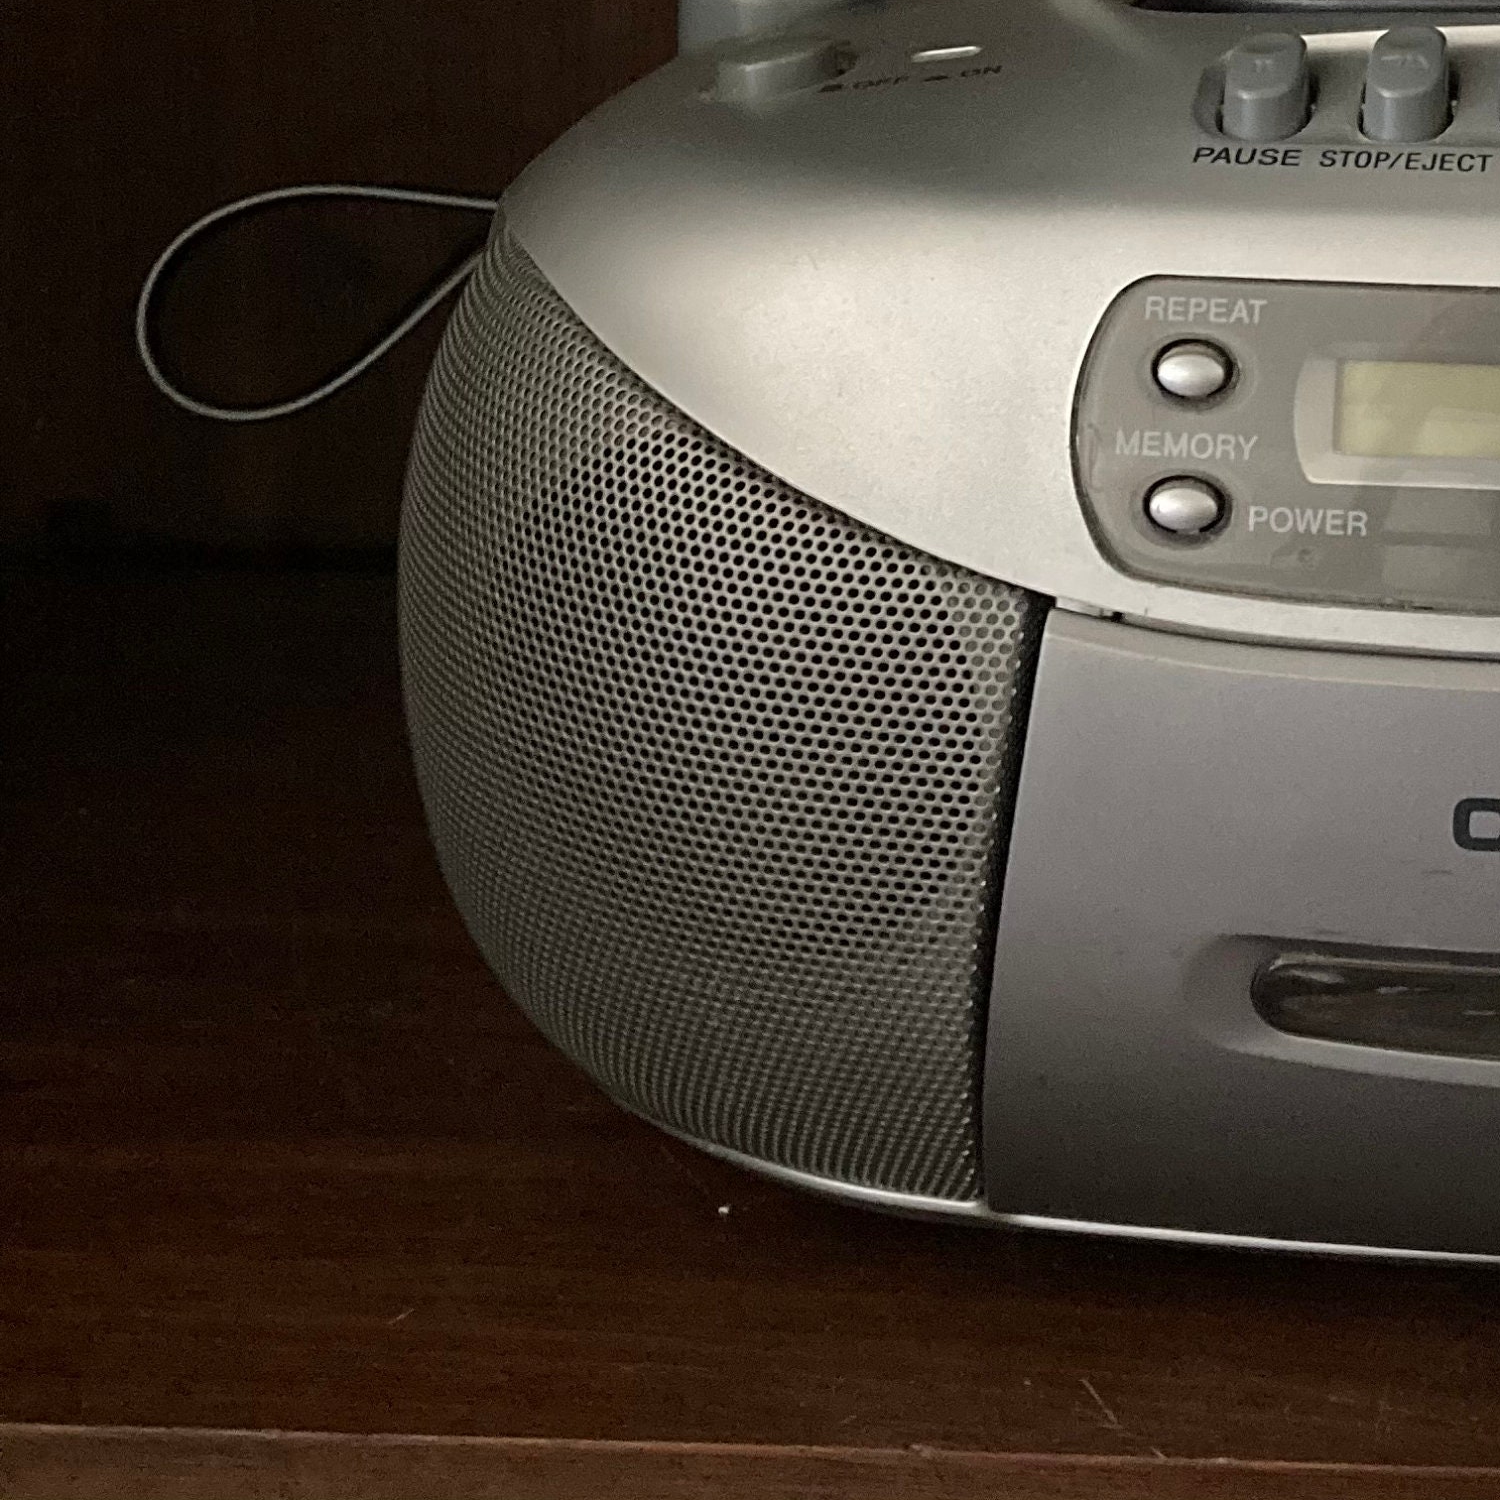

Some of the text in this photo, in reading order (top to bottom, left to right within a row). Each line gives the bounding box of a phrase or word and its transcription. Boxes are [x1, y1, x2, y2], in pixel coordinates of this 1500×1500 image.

[1192, 147, 1302, 167] PAUSE
[1319, 150, 1493, 173] STOP/EJECT
[1145, 296, 1268, 325] REPEAT
[1115, 430, 1258, 461] MEMORY
[1248, 506, 1368, 537] POWER
